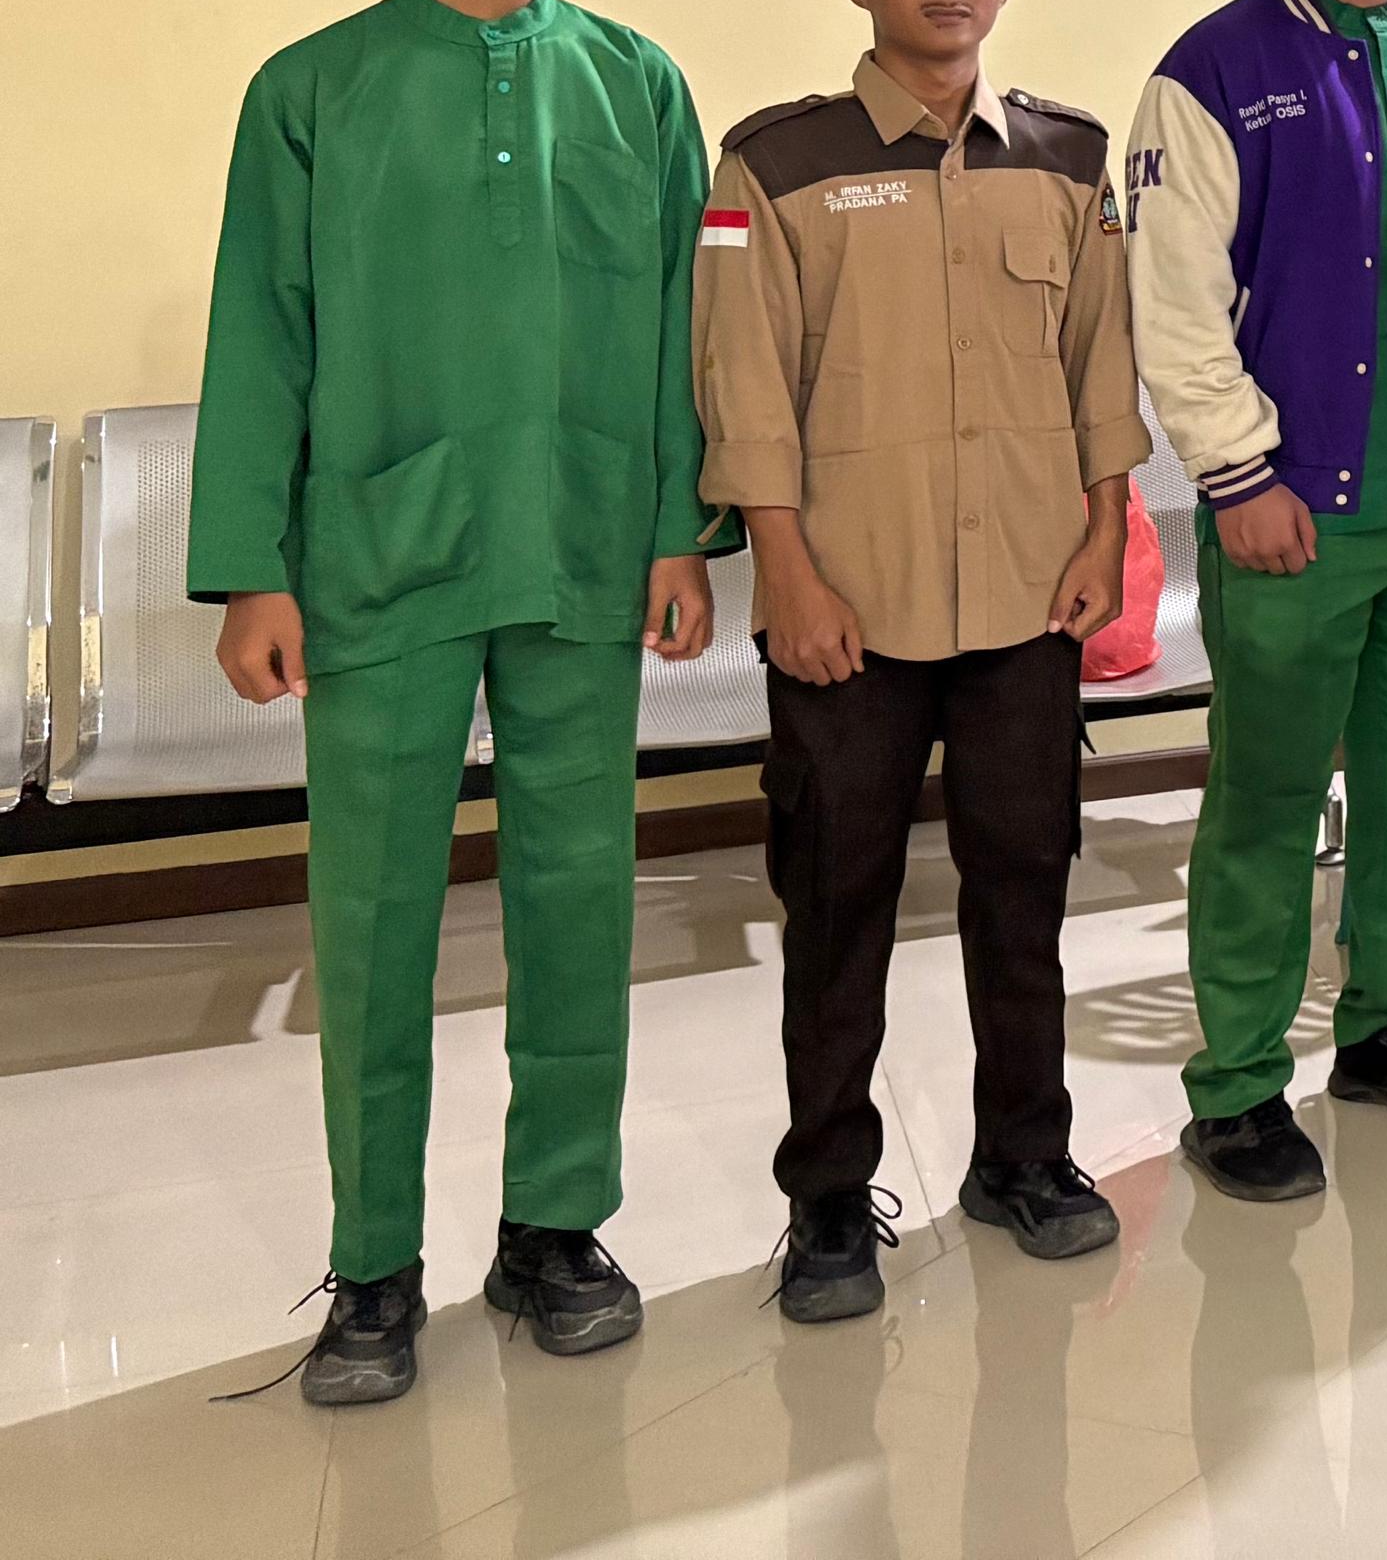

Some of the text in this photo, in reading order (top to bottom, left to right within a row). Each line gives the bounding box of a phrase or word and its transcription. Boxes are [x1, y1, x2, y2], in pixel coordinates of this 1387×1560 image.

[1275, 103, 1306, 120] OSIS
[840, 184, 872, 198] IRFAN
[875, 180, 907, 194] ZAKY
[828, 192, 908, 215] PRADANA PA
